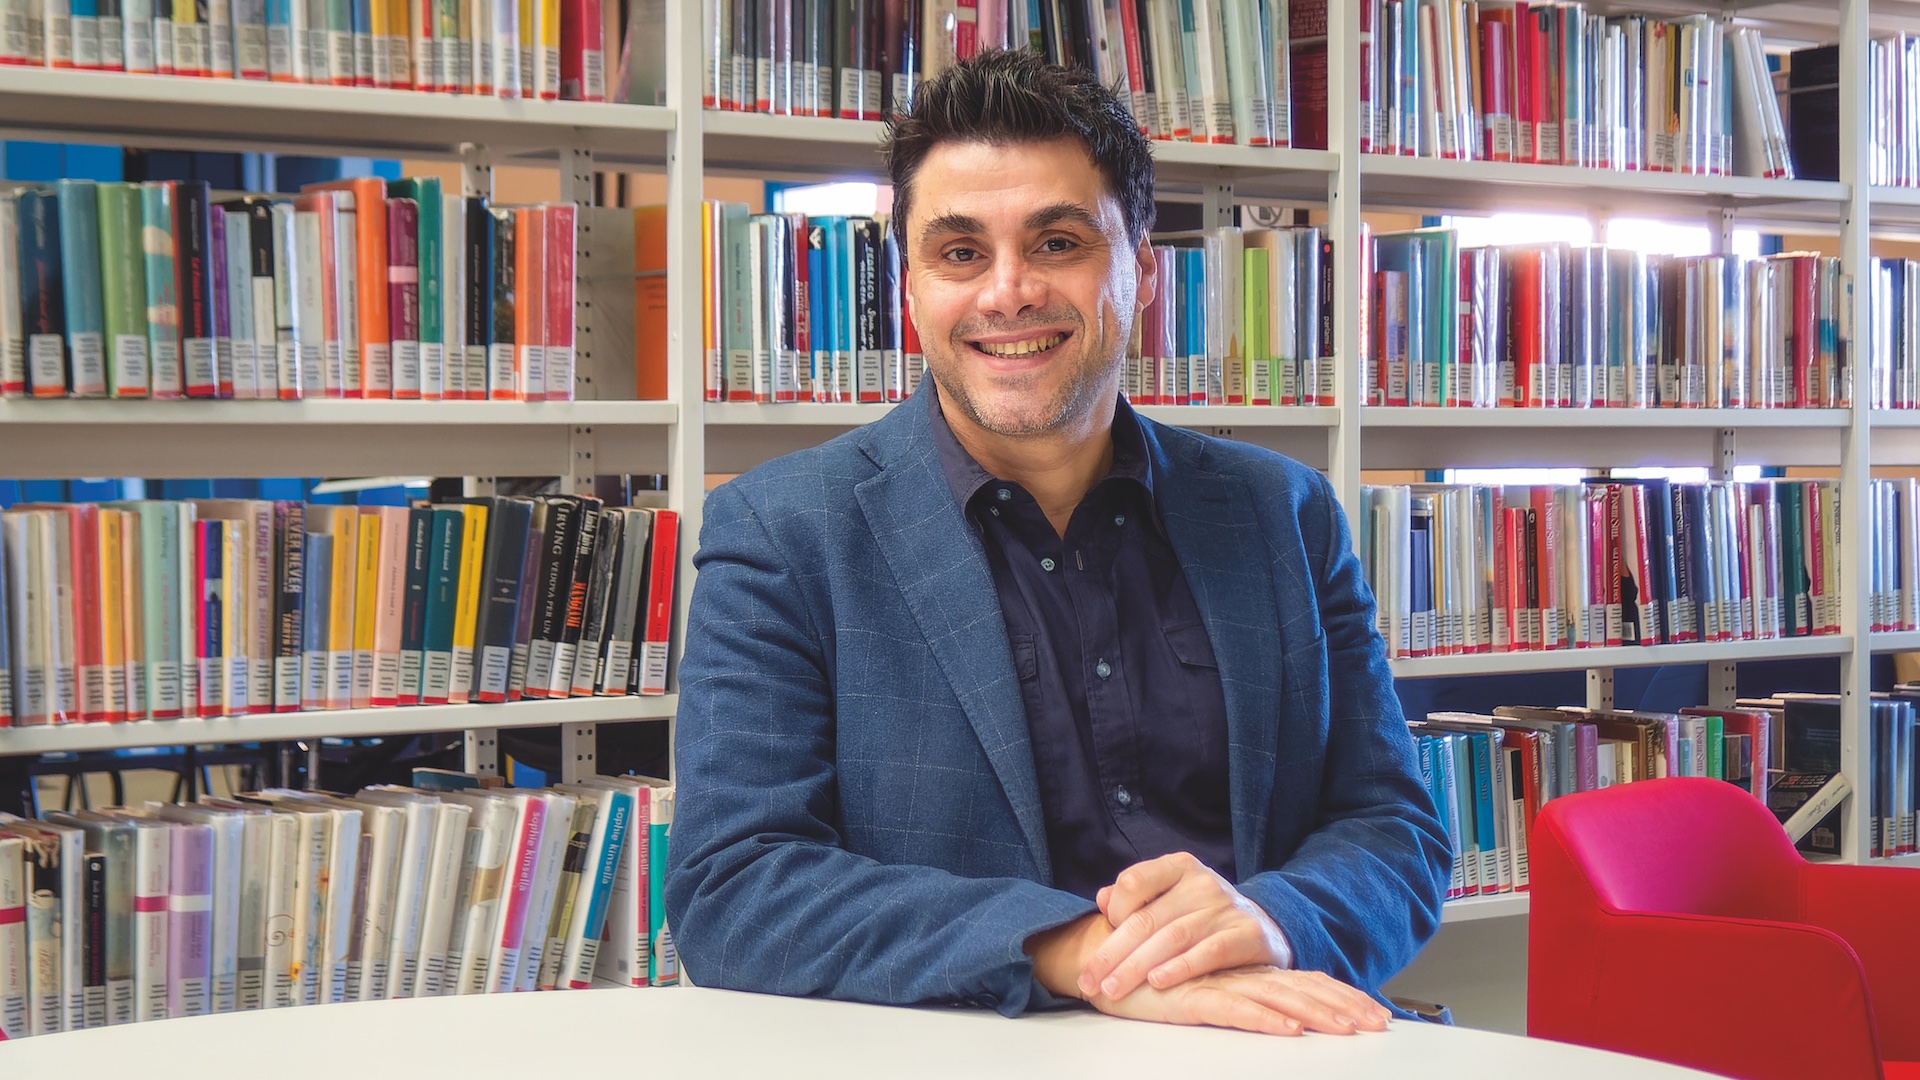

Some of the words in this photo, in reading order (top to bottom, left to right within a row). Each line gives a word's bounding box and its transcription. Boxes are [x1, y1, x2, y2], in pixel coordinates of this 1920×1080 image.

[866, 246, 876, 301] FEDERICO
[1609, 491, 1619, 519] DANIELLE
[289, 508, 303, 549] NEVER
[552, 507, 571, 555] IRVING
[1610, 519, 1621, 540] STEEL
[288, 552, 302, 593] NEVER
[547, 561, 560, 598] VEDOVA
[545, 600, 556, 617] PER
[543, 619, 553, 634] UN
[1646, 729, 1655, 755] DANIELLE
[1695, 726, 1705, 753] DANIELLE
[1647, 755, 1656, 777] STEEL
[1696, 753, 1706, 774] STEEL
[526, 811, 543, 847] sophie
[610, 806, 627, 841] sophie
[640, 804, 651, 836] sophie
[518, 848, 537, 892] kinsella
[601, 843, 622, 885] kinsella
[640, 838, 651, 876] kinsella
